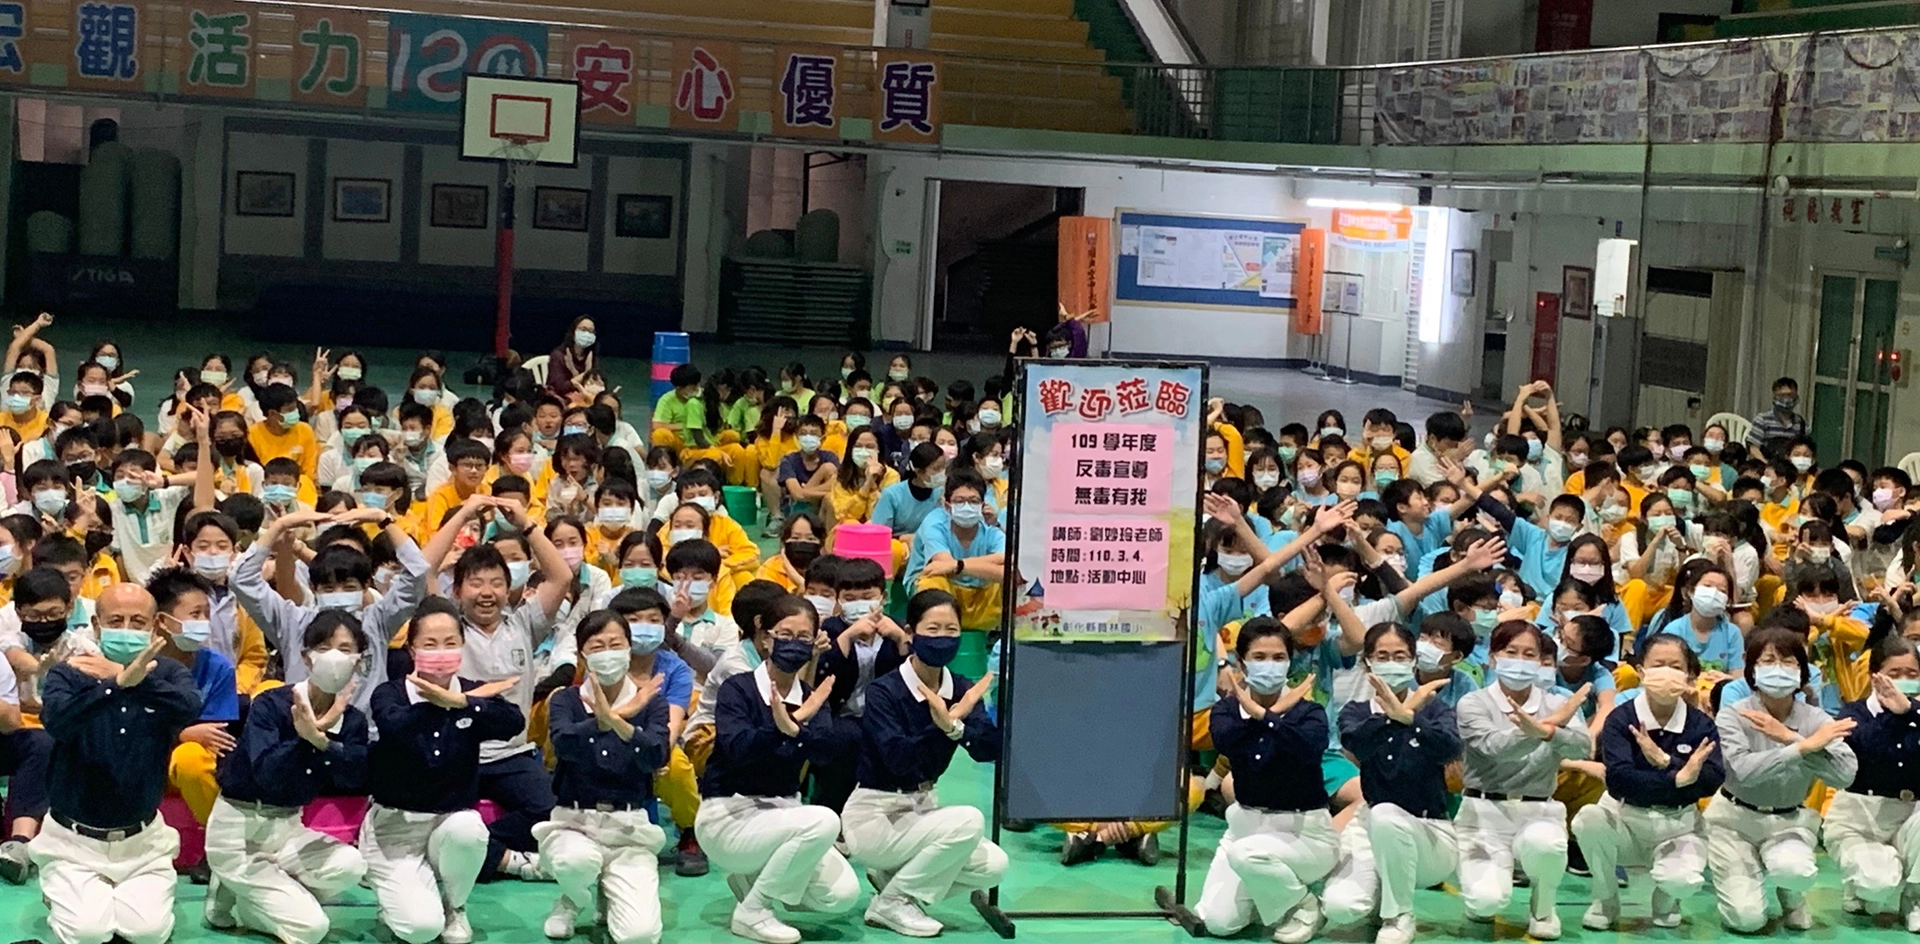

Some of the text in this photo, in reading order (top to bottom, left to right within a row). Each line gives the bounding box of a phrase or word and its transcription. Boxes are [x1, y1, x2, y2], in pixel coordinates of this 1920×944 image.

[1037, 376, 1191, 419] 歡迎蒞臨
[1071, 432, 1157, 452] 109 學年度
[1076, 459, 1148, 479] 反毒宣導
[1074, 486, 1147, 506] 無毒有我
